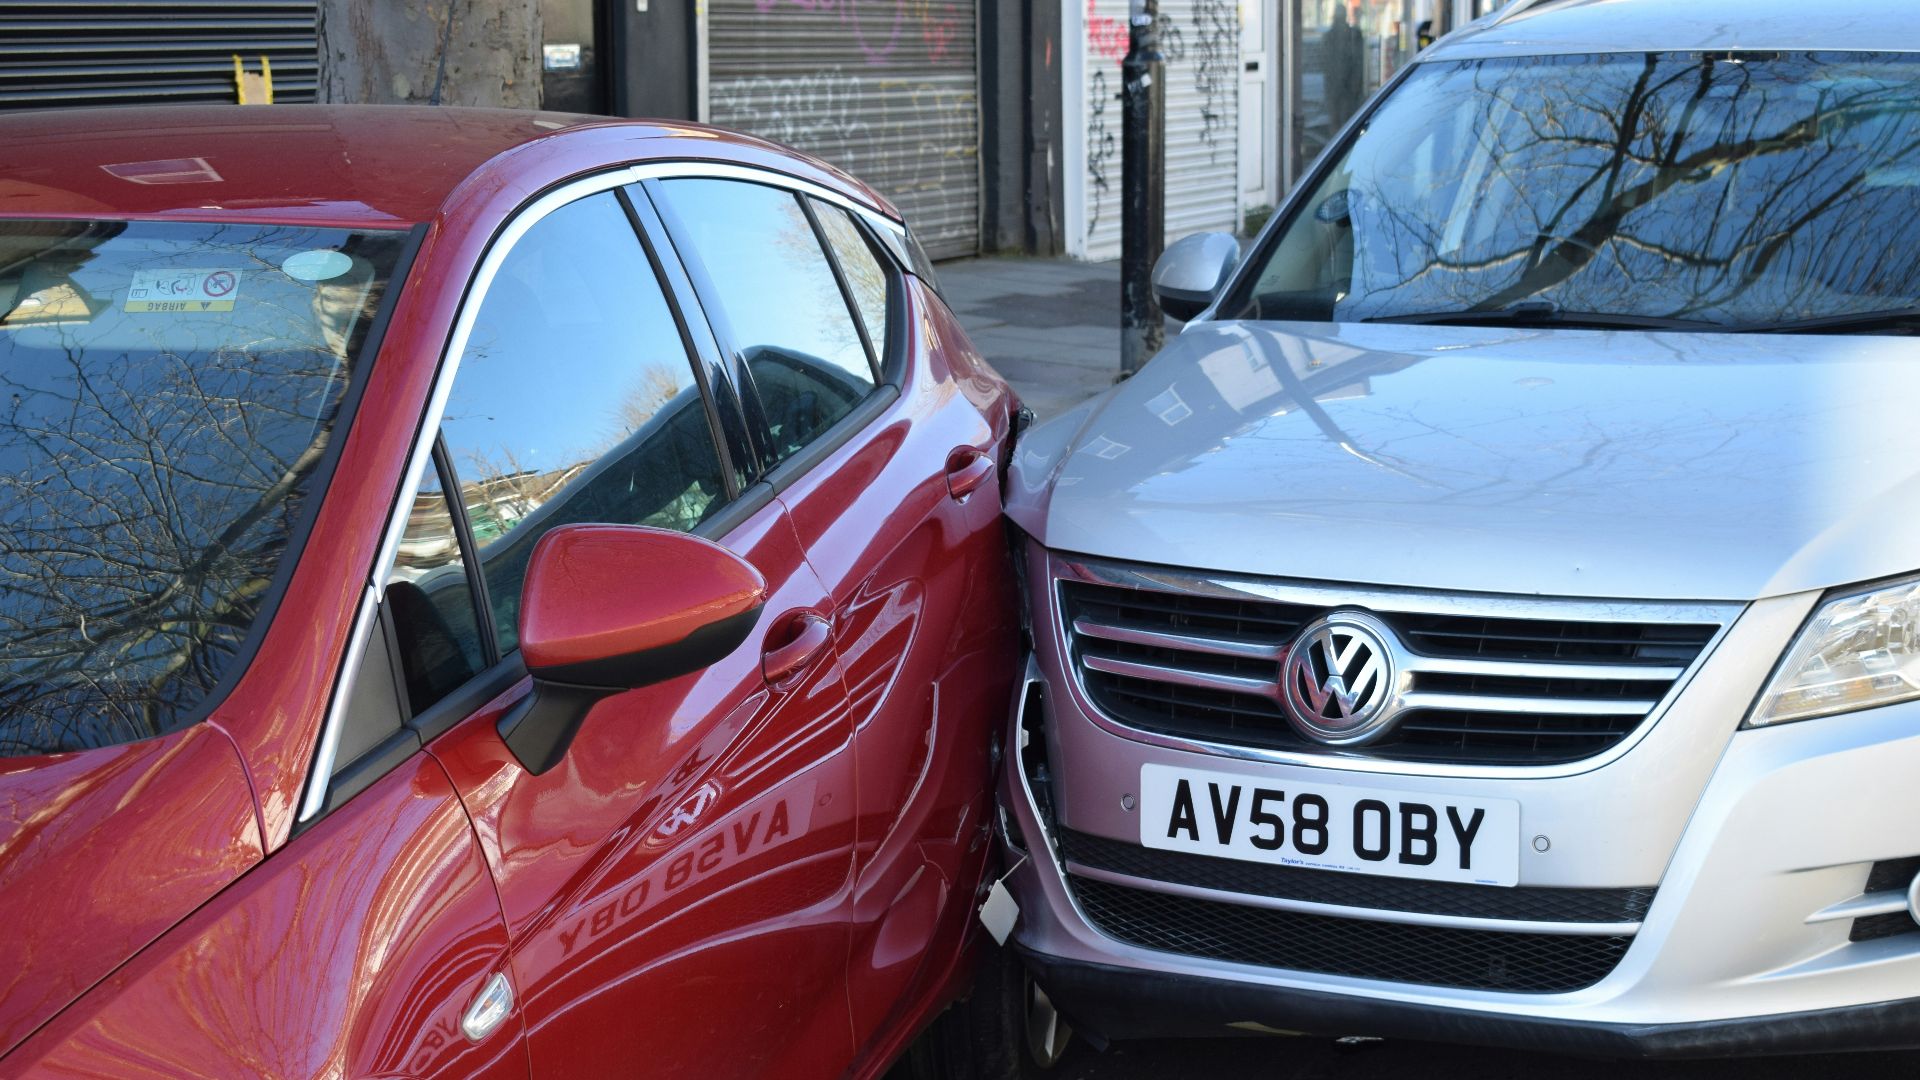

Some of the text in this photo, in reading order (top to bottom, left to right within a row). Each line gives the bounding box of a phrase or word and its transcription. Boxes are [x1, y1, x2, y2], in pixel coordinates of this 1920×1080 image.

[146, 302, 187, 312] AIRBAG
[1167, 779, 1485, 870] AV58 OBY
[1280, 857, 1304, 865] Taylor's
